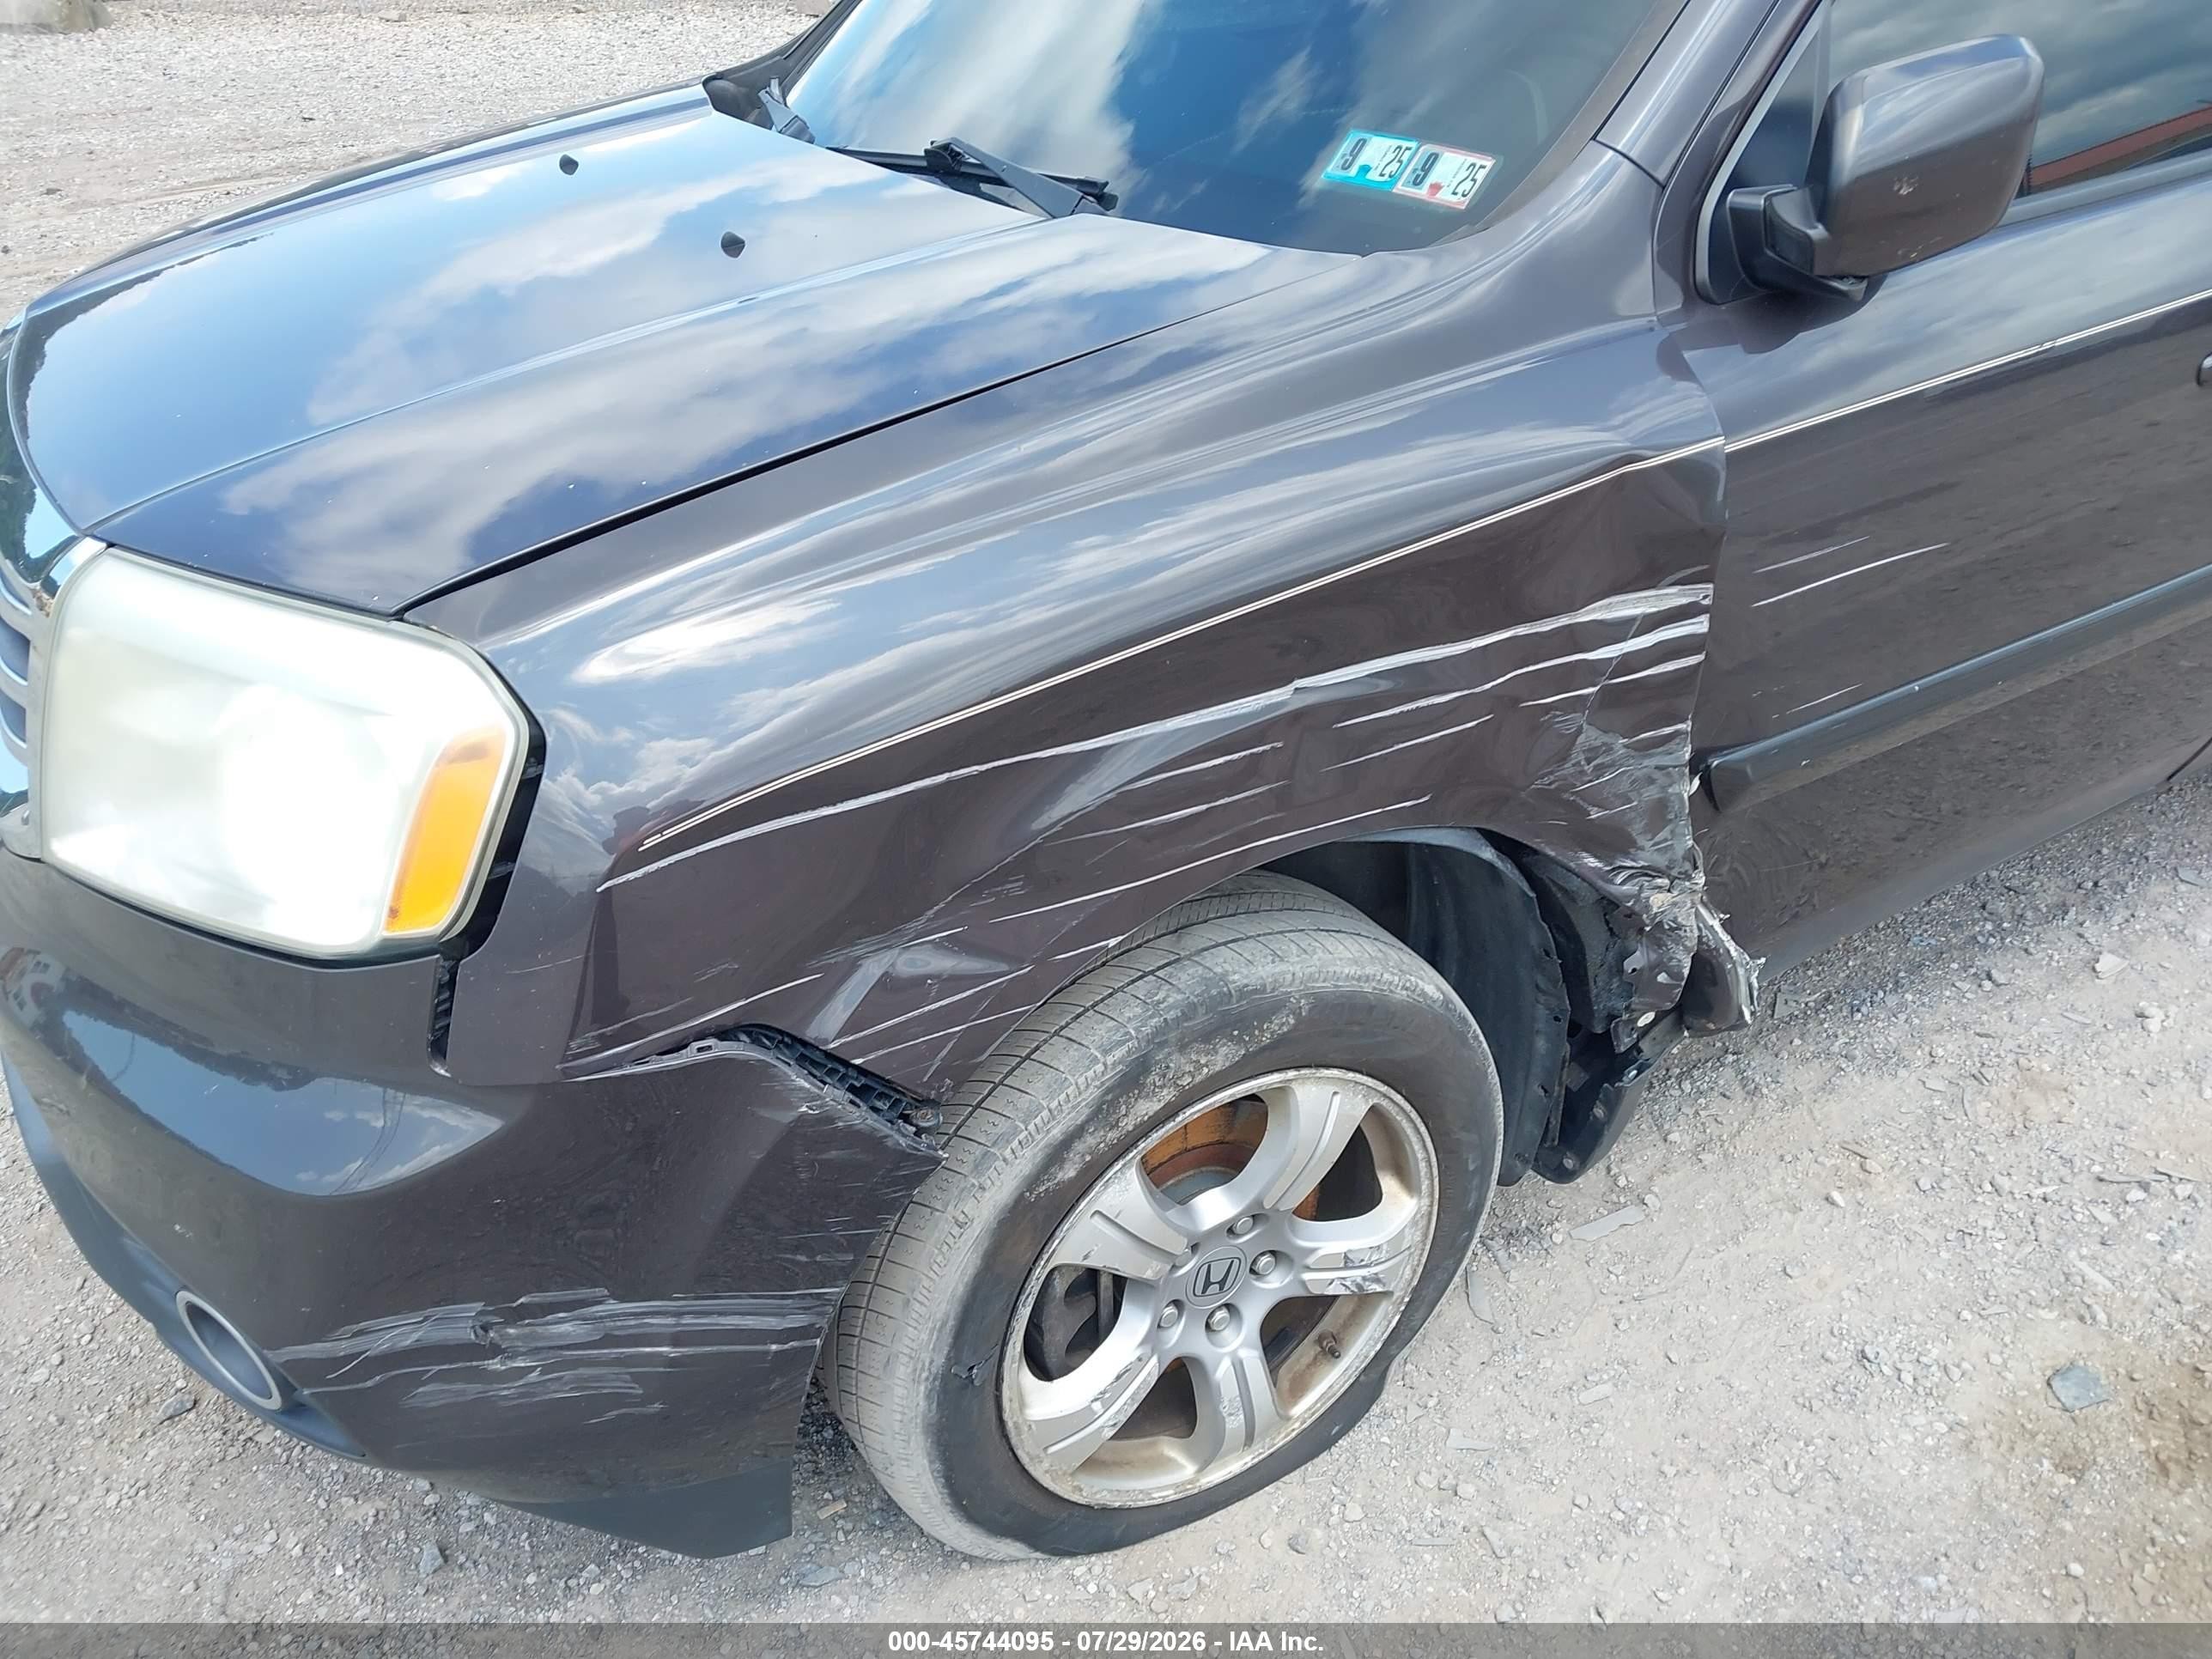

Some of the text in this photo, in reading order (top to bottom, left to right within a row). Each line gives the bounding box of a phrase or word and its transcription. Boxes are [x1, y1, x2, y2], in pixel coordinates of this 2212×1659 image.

[1340, 137, 1368, 171] 9
[1378, 144, 1413, 179] 25
[1412, 152, 1440, 186] 9
[1451, 161, 1488, 198] 25
